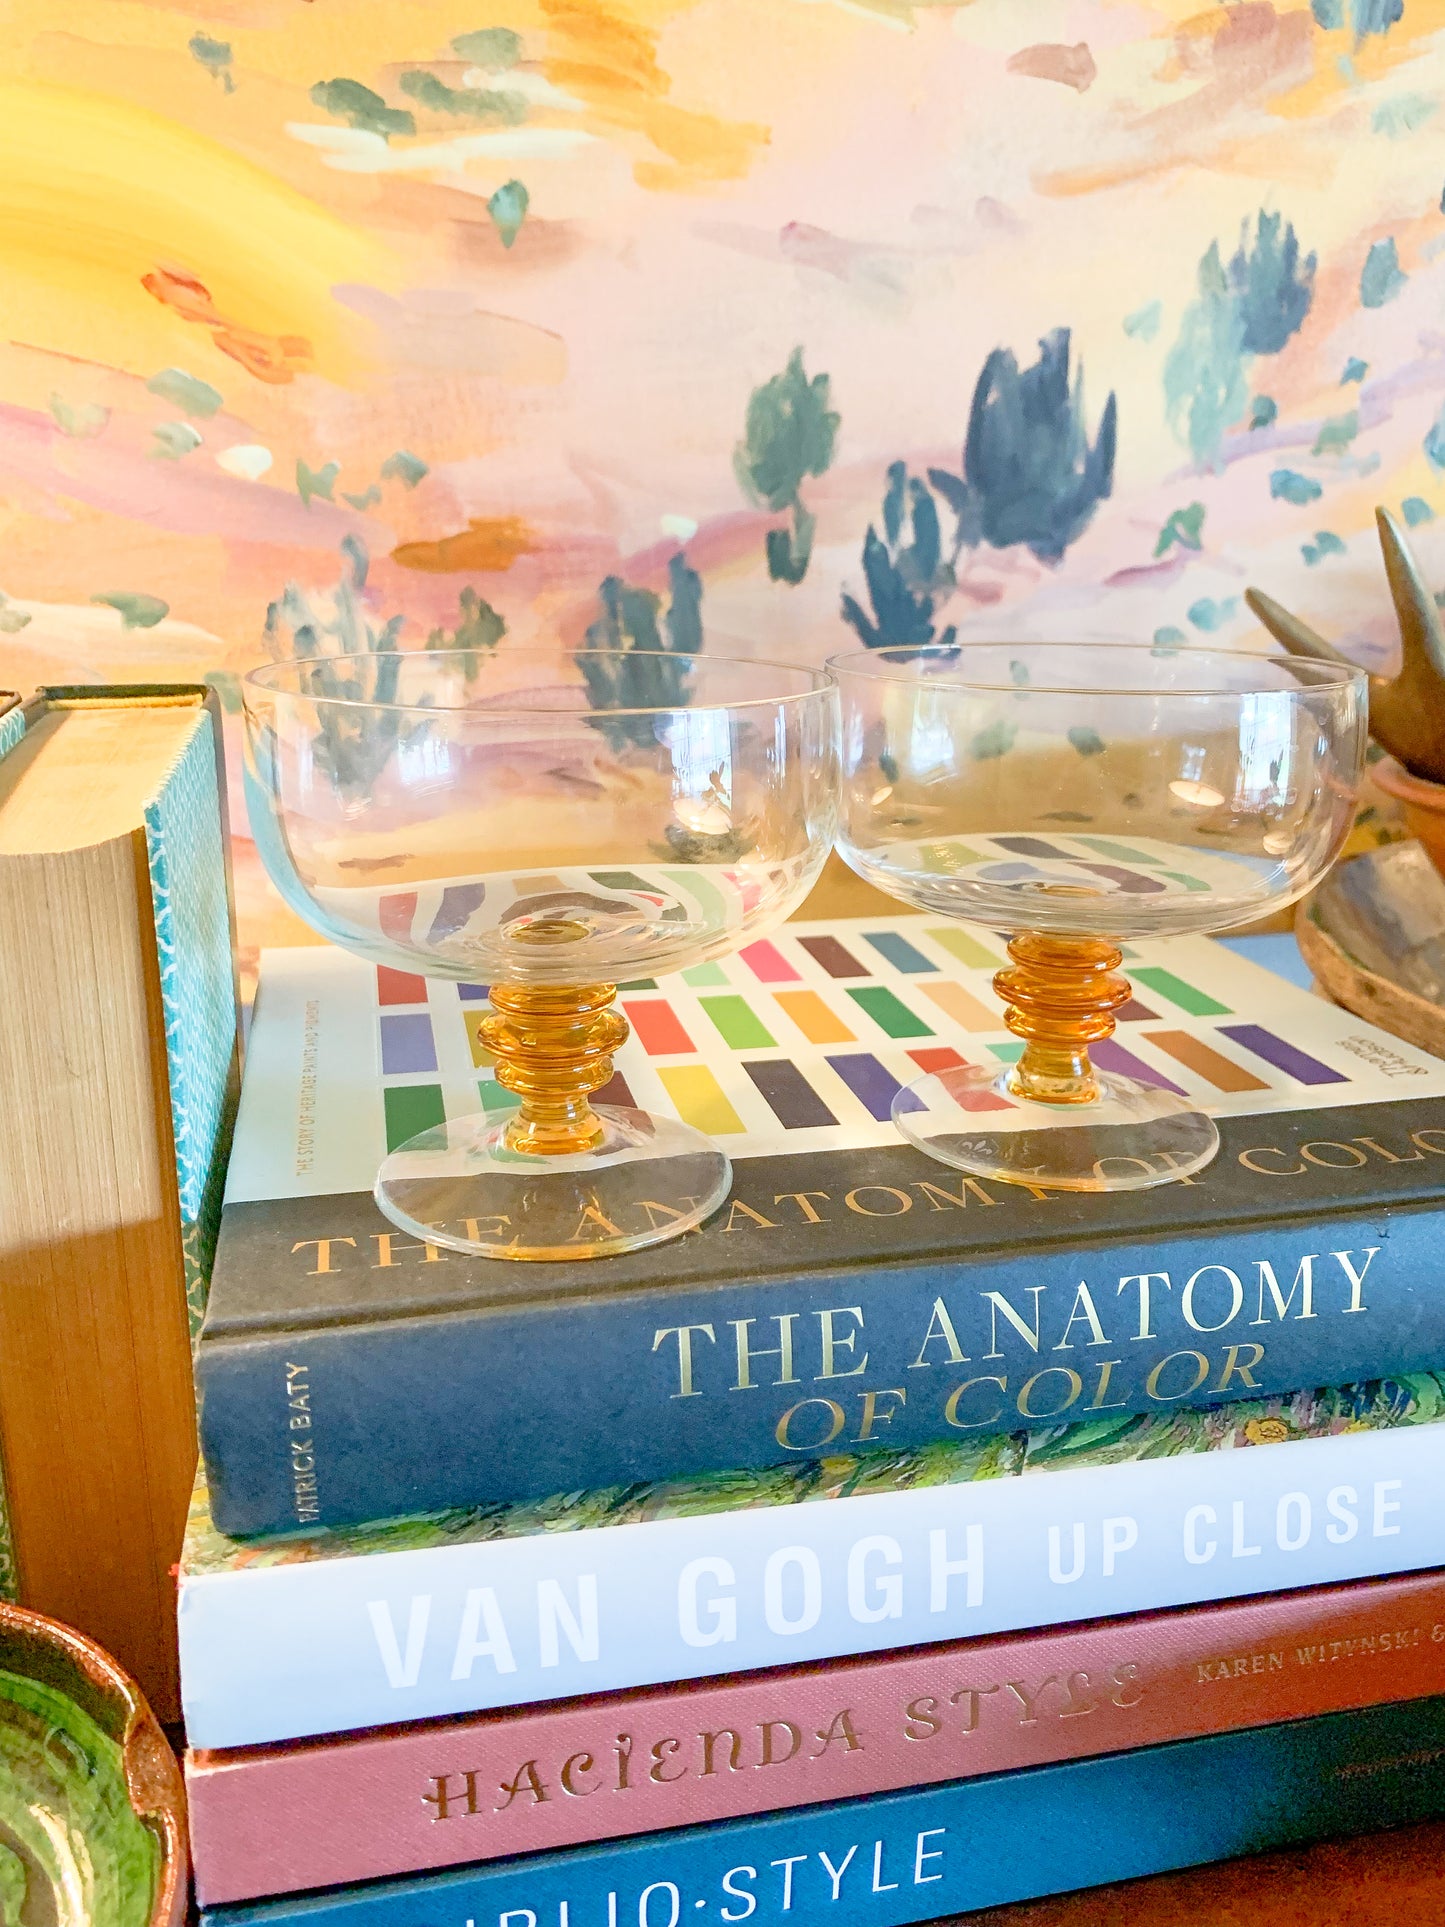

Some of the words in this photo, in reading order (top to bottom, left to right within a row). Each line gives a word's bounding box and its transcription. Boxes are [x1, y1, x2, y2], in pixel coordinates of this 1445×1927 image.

[291, 1214, 518, 1276] THE
[652, 1307, 869, 1400] THE
[913, 1247, 1382, 1369] ANATOMY
[286, 1361, 311, 1430] BATY
[774, 1390, 907, 1452] OF
[945, 1343, 1266, 1428] COLOR
[291, 1438, 320, 1523] PATRICK
[367, 1573, 602, 1689] VAN
[677, 1523, 986, 1648] GOGH
[1048, 1516, 1139, 1584] UP
[1183, 1480, 1402, 1566] CLOSE
[1197, 1651, 1284, 1683] KAREN
[420, 1708, 863, 1823] HACIENDA
[903, 1661, 1146, 1741] STYLE
[465, 1828, 946, 1927] IO·STYLE
